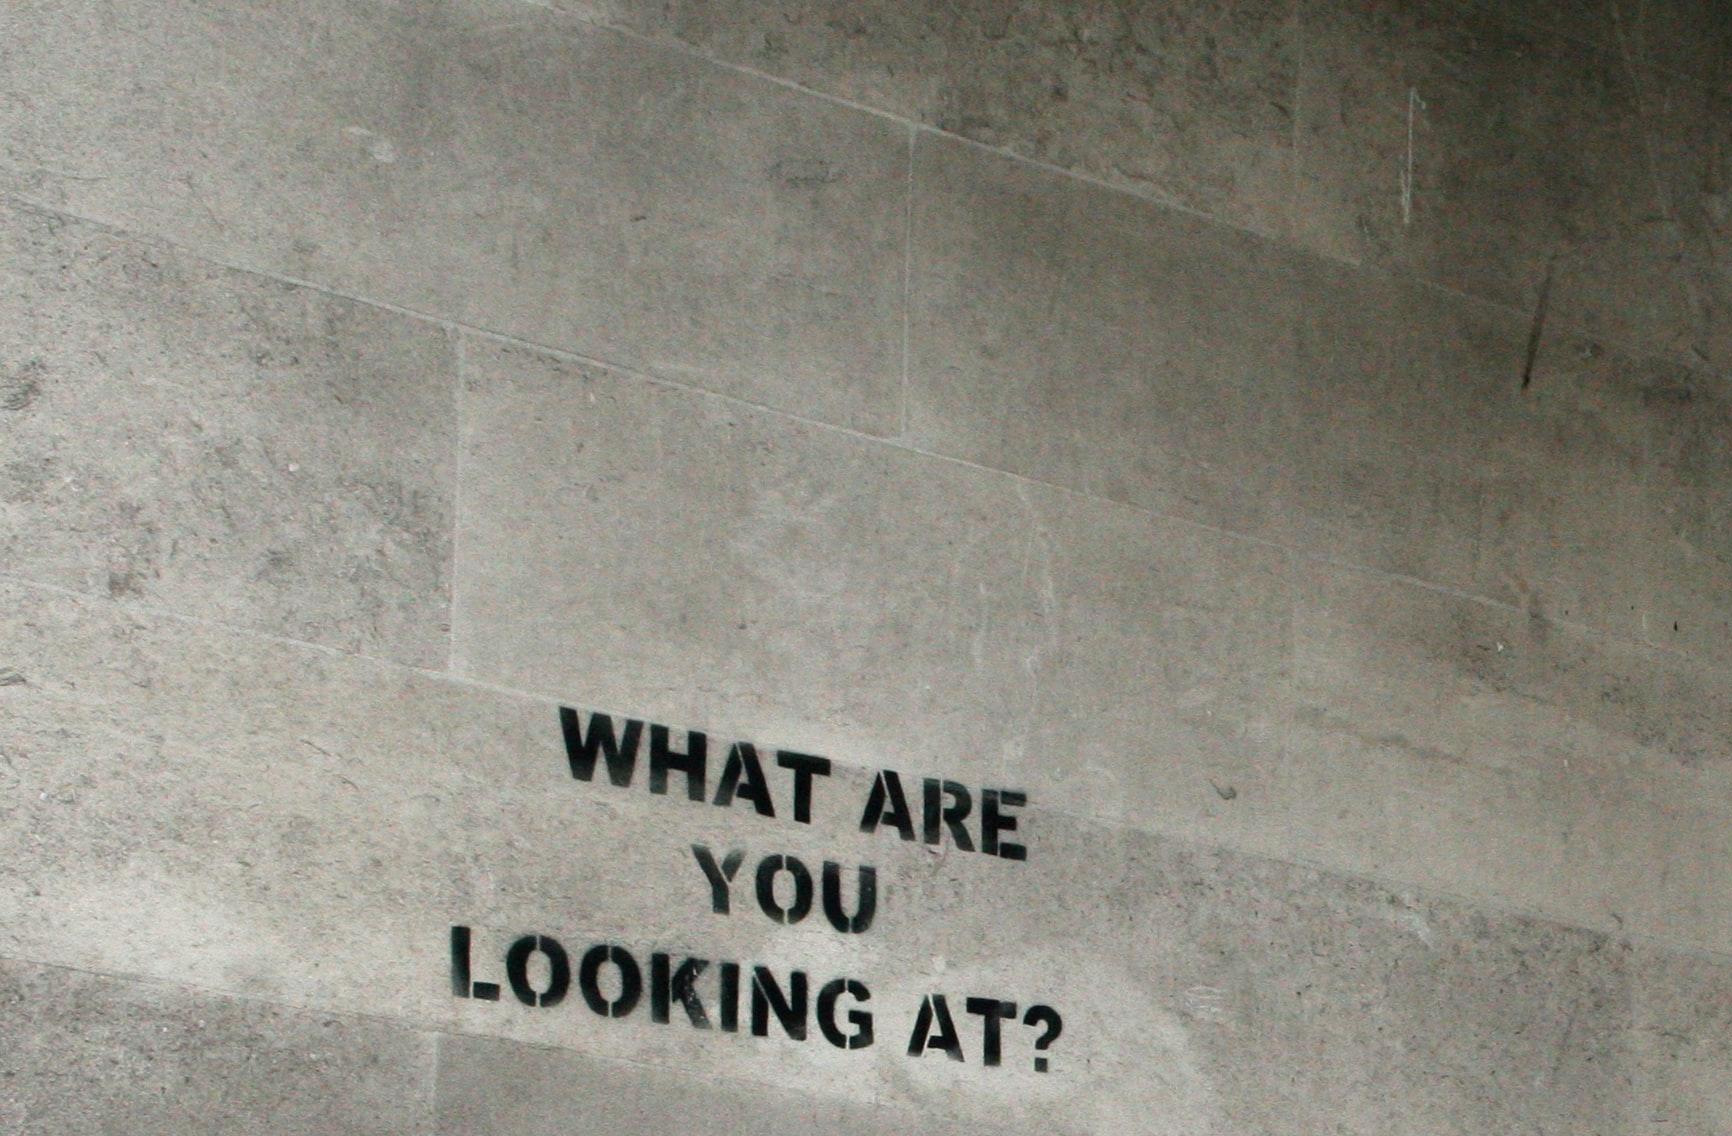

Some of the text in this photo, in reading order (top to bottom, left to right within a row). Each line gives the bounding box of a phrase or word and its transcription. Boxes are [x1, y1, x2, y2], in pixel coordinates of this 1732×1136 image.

[559, 706, 1027, 861] WHAT ARE
[692, 844, 877, 934] YOU
[451, 925, 1063, 1073] LOOKING AT?
